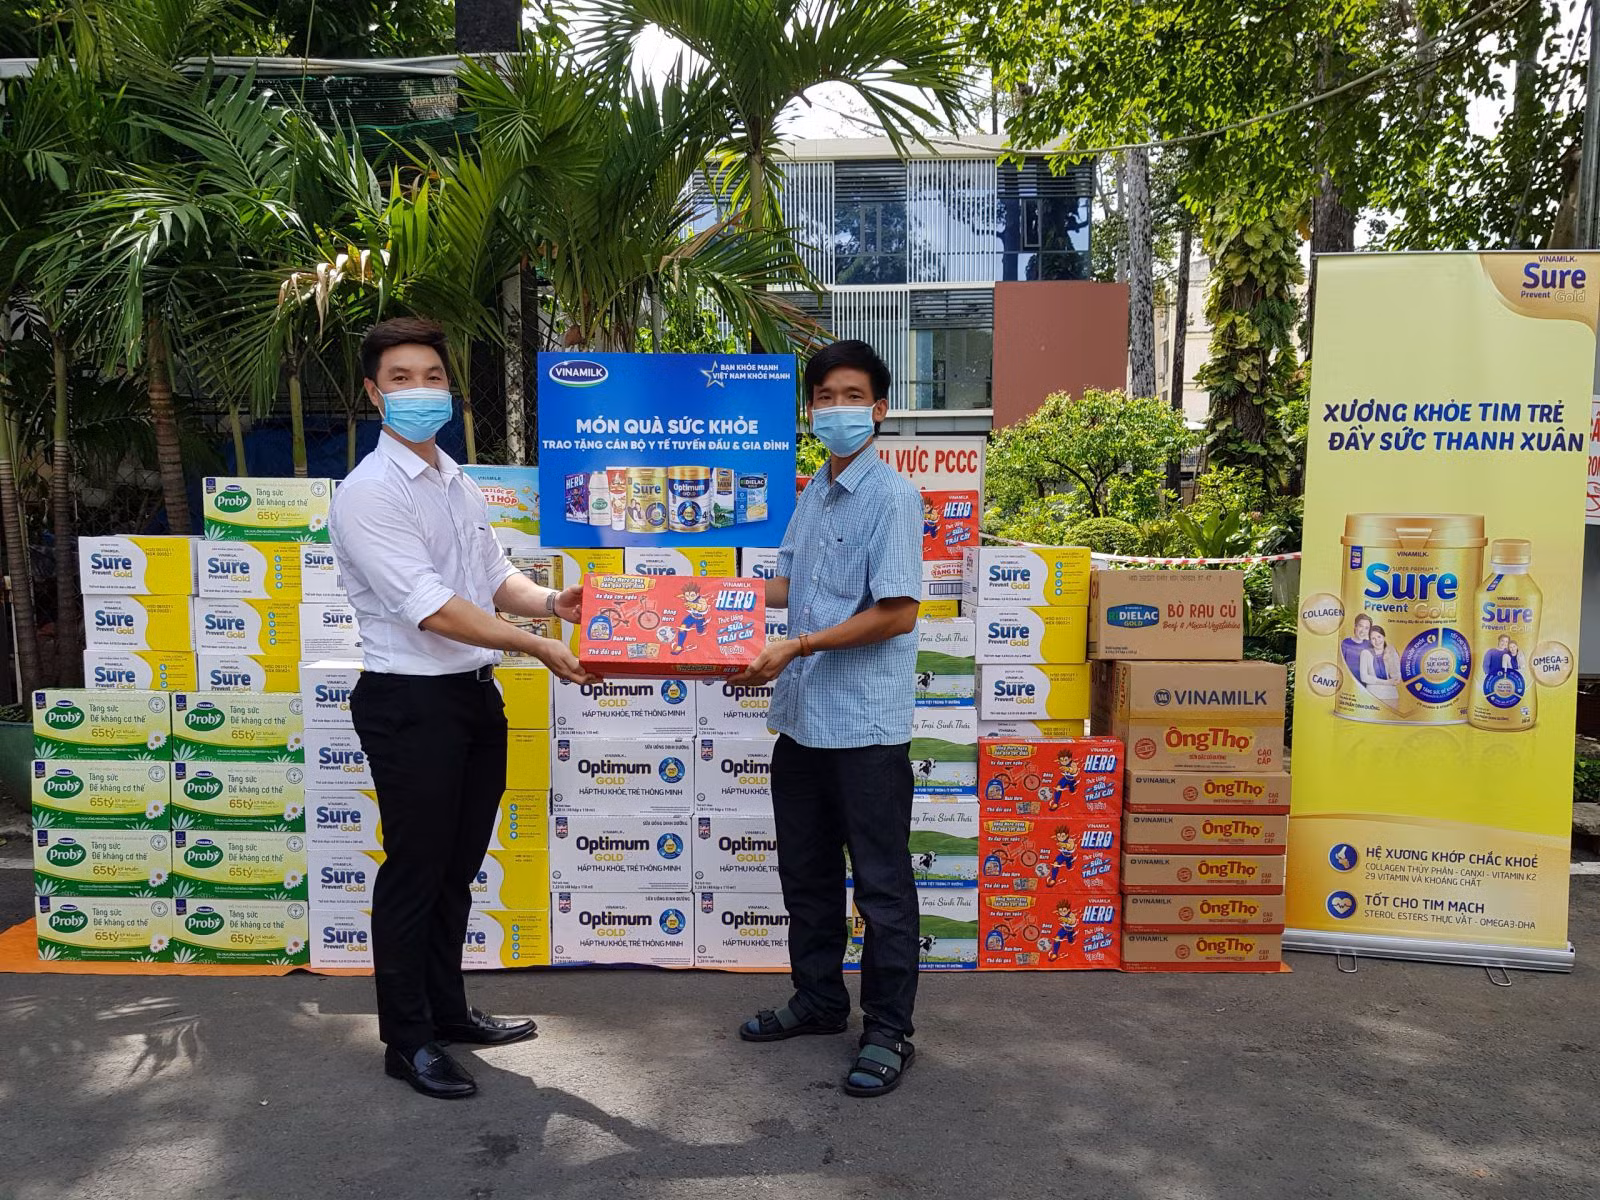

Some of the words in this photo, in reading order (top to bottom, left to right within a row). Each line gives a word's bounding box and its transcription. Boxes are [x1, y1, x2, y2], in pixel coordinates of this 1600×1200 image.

[1522, 263, 1586, 289] Sure
[1520, 290, 1550, 299] Prevent
[1554, 290, 1586, 303] Gold
[555, 368, 603, 378] VINAMILK
[720, 364, 735, 372] BẠN
[736, 362, 756, 370] KHỎE
[758, 364, 778, 372] MẠNH
[713, 372, 728, 380] VIỆT
[748, 371, 768, 379] KHỎE
[769, 373, 790, 381] MẠNH
[1323, 399, 1408, 422] XƯƠNG
[1413, 398, 1472, 422] KHỎE
[1478, 402, 1520, 422] TIM
[1527, 400, 1565, 423] TRẺ
[576, 416, 620, 434] MÓN
[624, 416, 664, 434] QUÀ
[668, 416, 704, 434] SỨC
[708, 416, 758, 434] KHỎE
[542, 440, 572, 449] TRAO
[574, 438, 603, 452] TẶNG
[605, 439, 628, 449] CÁN
[630, 439, 646, 452] BỘ
[648, 441, 657, 450] Y
[658, 438, 670, 450] TẾ
[672, 438, 706, 450] TUYẾN
[732, 441, 740, 450] &
[742, 442, 761, 450] GIA
[763, 440, 789, 450] ĐÌNH
[1328, 424, 1376, 450] ĐẦY
[1380, 426, 1427, 450] SỨC
[1432, 432, 1515, 451] THANH
[1520, 426, 1584, 452] XUÂN
[896, 445, 929, 478] VỰC
[934, 450, 978, 474] PCCC
[566, 474, 584, 489] HERO
[633, 482, 661, 494] Sure
[256, 488, 271, 497] Tăng
[217, 495, 249, 507] Proby
[266, 498, 286, 508] kháng
[944, 502, 971, 517] HERO
[91, 554, 132, 570] Sure
[208, 557, 250, 574] Sure
[114, 570, 132, 578] Gold
[989, 566, 1030, 582] Sure
[1364, 562, 1458, 600] Sure
[1010, 582, 1030, 590] Gold
[716, 590, 756, 610] HERO
[1168, 600, 1184, 618] BÒ
[1190, 604, 1214, 618] RAU
[1220, 599, 1236, 618] CỦ
[1302, 608, 1345, 620] COLLAGEN
[1364, 600, 1408, 613] Prevent
[1414, 601, 1457, 619] Gold
[1482, 602, 1533, 624] Sure
[95, 610, 134, 627] Sure
[1186, 621, 1207, 630] Mixed
[718, 632, 736, 644] TRÁI
[739, 629, 754, 640] CÂY
[988, 622, 1030, 639] Sure
[1533, 656, 1569, 666] OMEGA-3
[1542, 664, 1560, 672] DHA
[94, 667, 136, 683] Sure
[1312, 674, 1339, 688] CANXI
[580, 682, 654, 700] Optimum
[994, 680, 1036, 696] Sure
[1174, 690, 1268, 705] VINAMILK
[48, 711, 81, 724] Proby
[188, 712, 222, 726] Proby
[936, 720, 953, 729] Sinh
[319, 747, 364, 765] Sure
[1084, 754, 1116, 772] HERO
[578, 760, 652, 778] Optimum
[46, 779, 81, 793] Proby
[186, 781, 221, 795] Proby
[596, 777, 625, 785] GOLD
[665, 788, 683, 796] MINH
[576, 836, 650, 854] Optimum
[1080, 831, 1113, 848] HERO
[49, 848, 84, 862] Proby
[187, 849, 221, 863] Proby
[1366, 846, 1382, 860] HỆ
[1386, 848, 1428, 861] XƯƠNG
[1432, 850, 1466, 863] KHỚP
[1469, 851, 1502, 866] CHẮC
[1505, 854, 1538, 868] KHOẺ
[321, 867, 366, 884] Sure
[1366, 862, 1406, 872] COLLAGEN
[1408, 864, 1429, 874] THỦY
[1431, 866, 1454, 875] PHÂN
[1460, 868, 1484, 877] CANXI
[1492, 871, 1524, 880] VITAMIN
[1526, 873, 1536, 881] K2
[1365, 872, 1375, 880] 29
[1378, 873, 1409, 882] VITAMIN
[1412, 874, 1422, 883] VÀ
[1424, 876, 1458, 886] KHOÁNG
[1460, 876, 1481, 887] CHẤT
[1364, 892, 1390, 906] TỐT
[1393, 897, 1418, 908] CHO
[1422, 899, 1444, 911] TIM
[1448, 901, 1484, 915] MẠCH
[51, 914, 85, 928] Proby
[579, 911, 652, 929] Optimum
[1082, 906, 1113, 922] HERO
[1364, 910, 1395, 919] STEROL
[1398, 912, 1428, 922] ESTERS
[1431, 914, 1453, 924] THỰC
[1455, 915, 1472, 925] VẬT
[1480, 918, 1536, 929] OMEGA3-DHA
